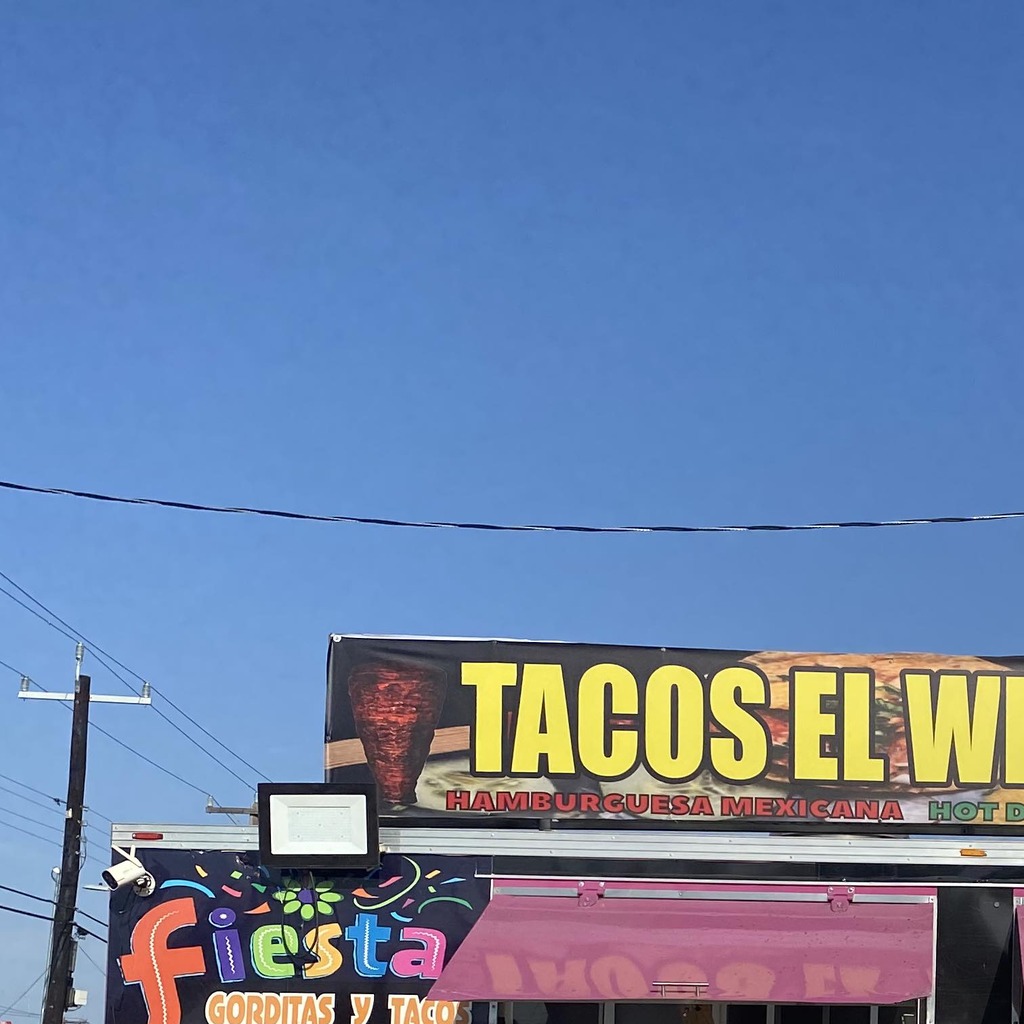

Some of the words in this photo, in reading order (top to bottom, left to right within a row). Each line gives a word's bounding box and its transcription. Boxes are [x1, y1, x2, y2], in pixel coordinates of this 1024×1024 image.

[461, 661, 771, 780] TACOS
[793, 671, 884, 781] EL
[446, 789, 714, 817] HAMBURGUESA
[720, 796, 904, 822] MEXICANA
[928, 801, 1001, 824] HOT
